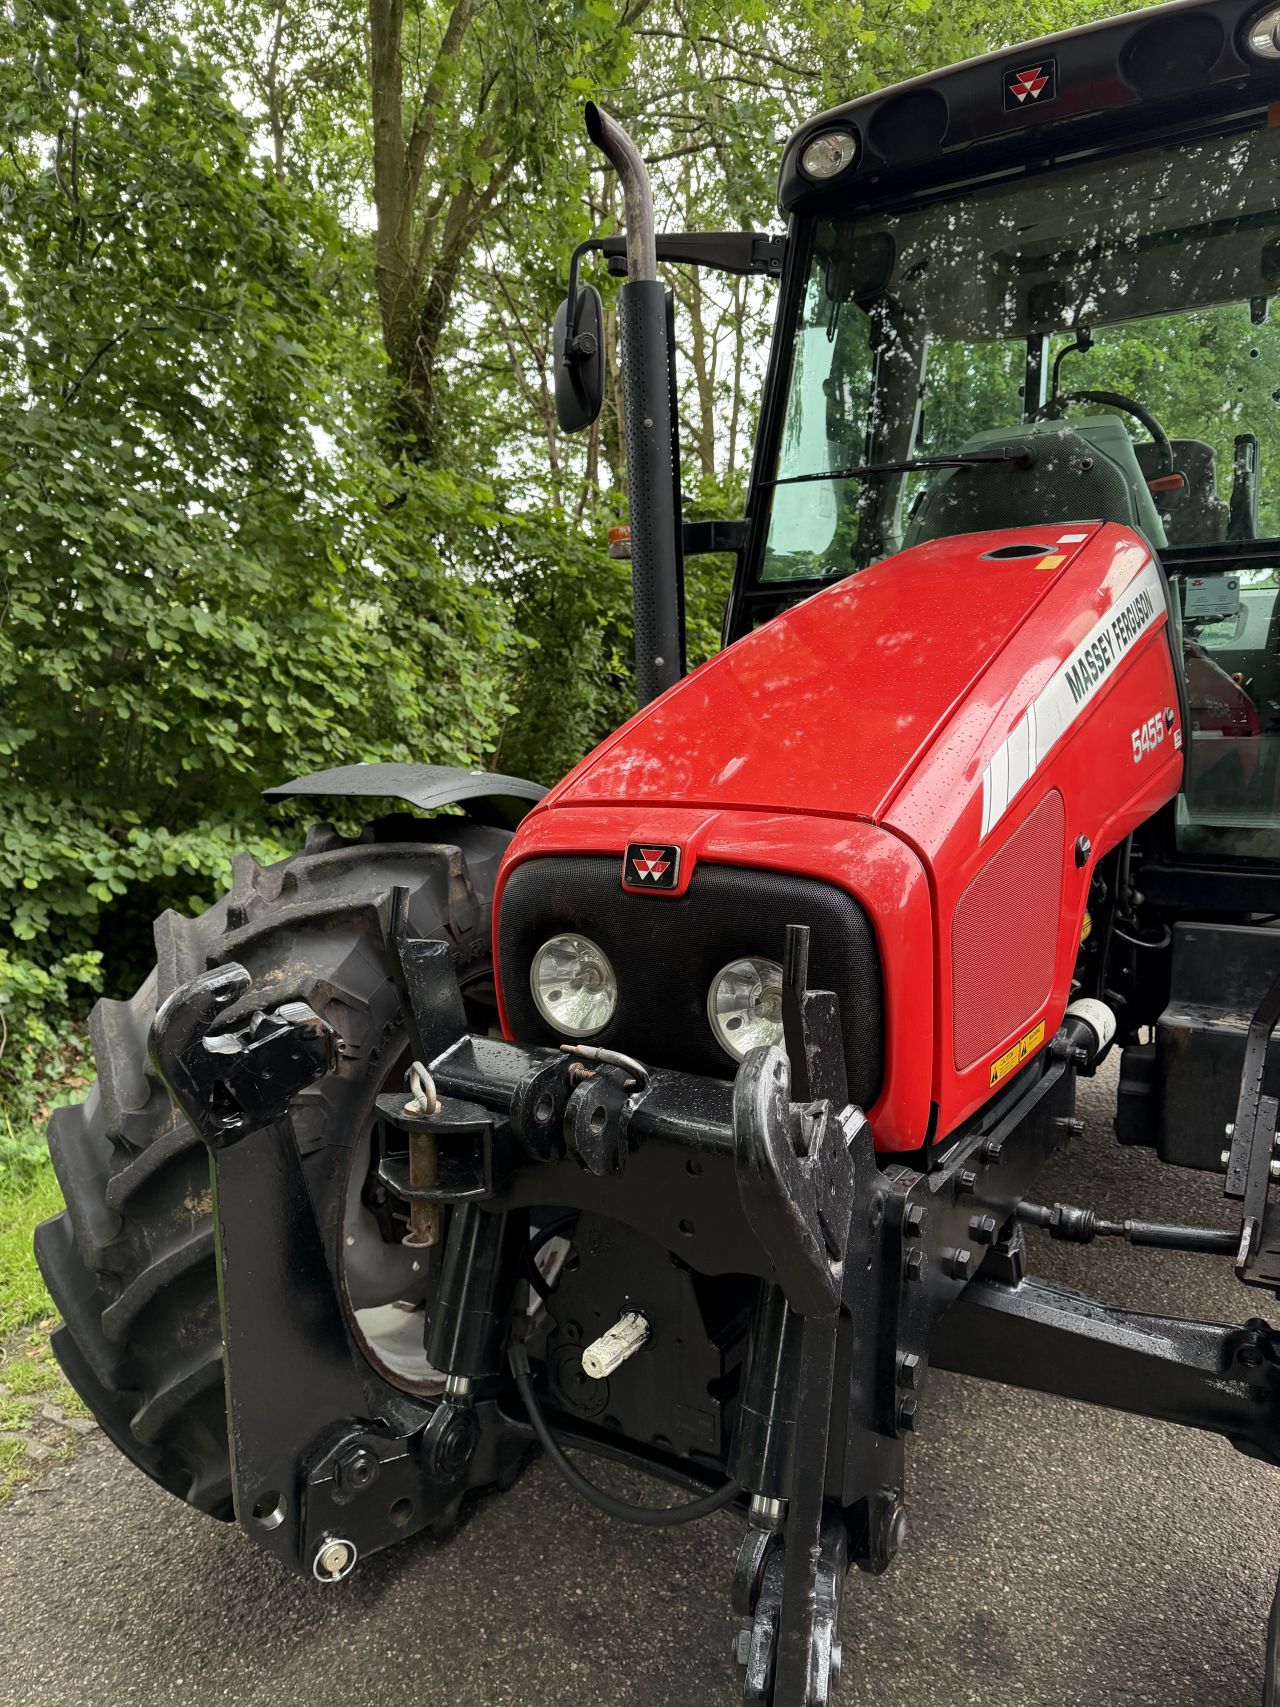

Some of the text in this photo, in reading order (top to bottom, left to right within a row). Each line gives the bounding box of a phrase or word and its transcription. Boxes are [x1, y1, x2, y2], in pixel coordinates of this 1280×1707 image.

[1064, 588, 1154, 703] MASSEY FERGUSON
[1131, 711, 1164, 764] 5455
